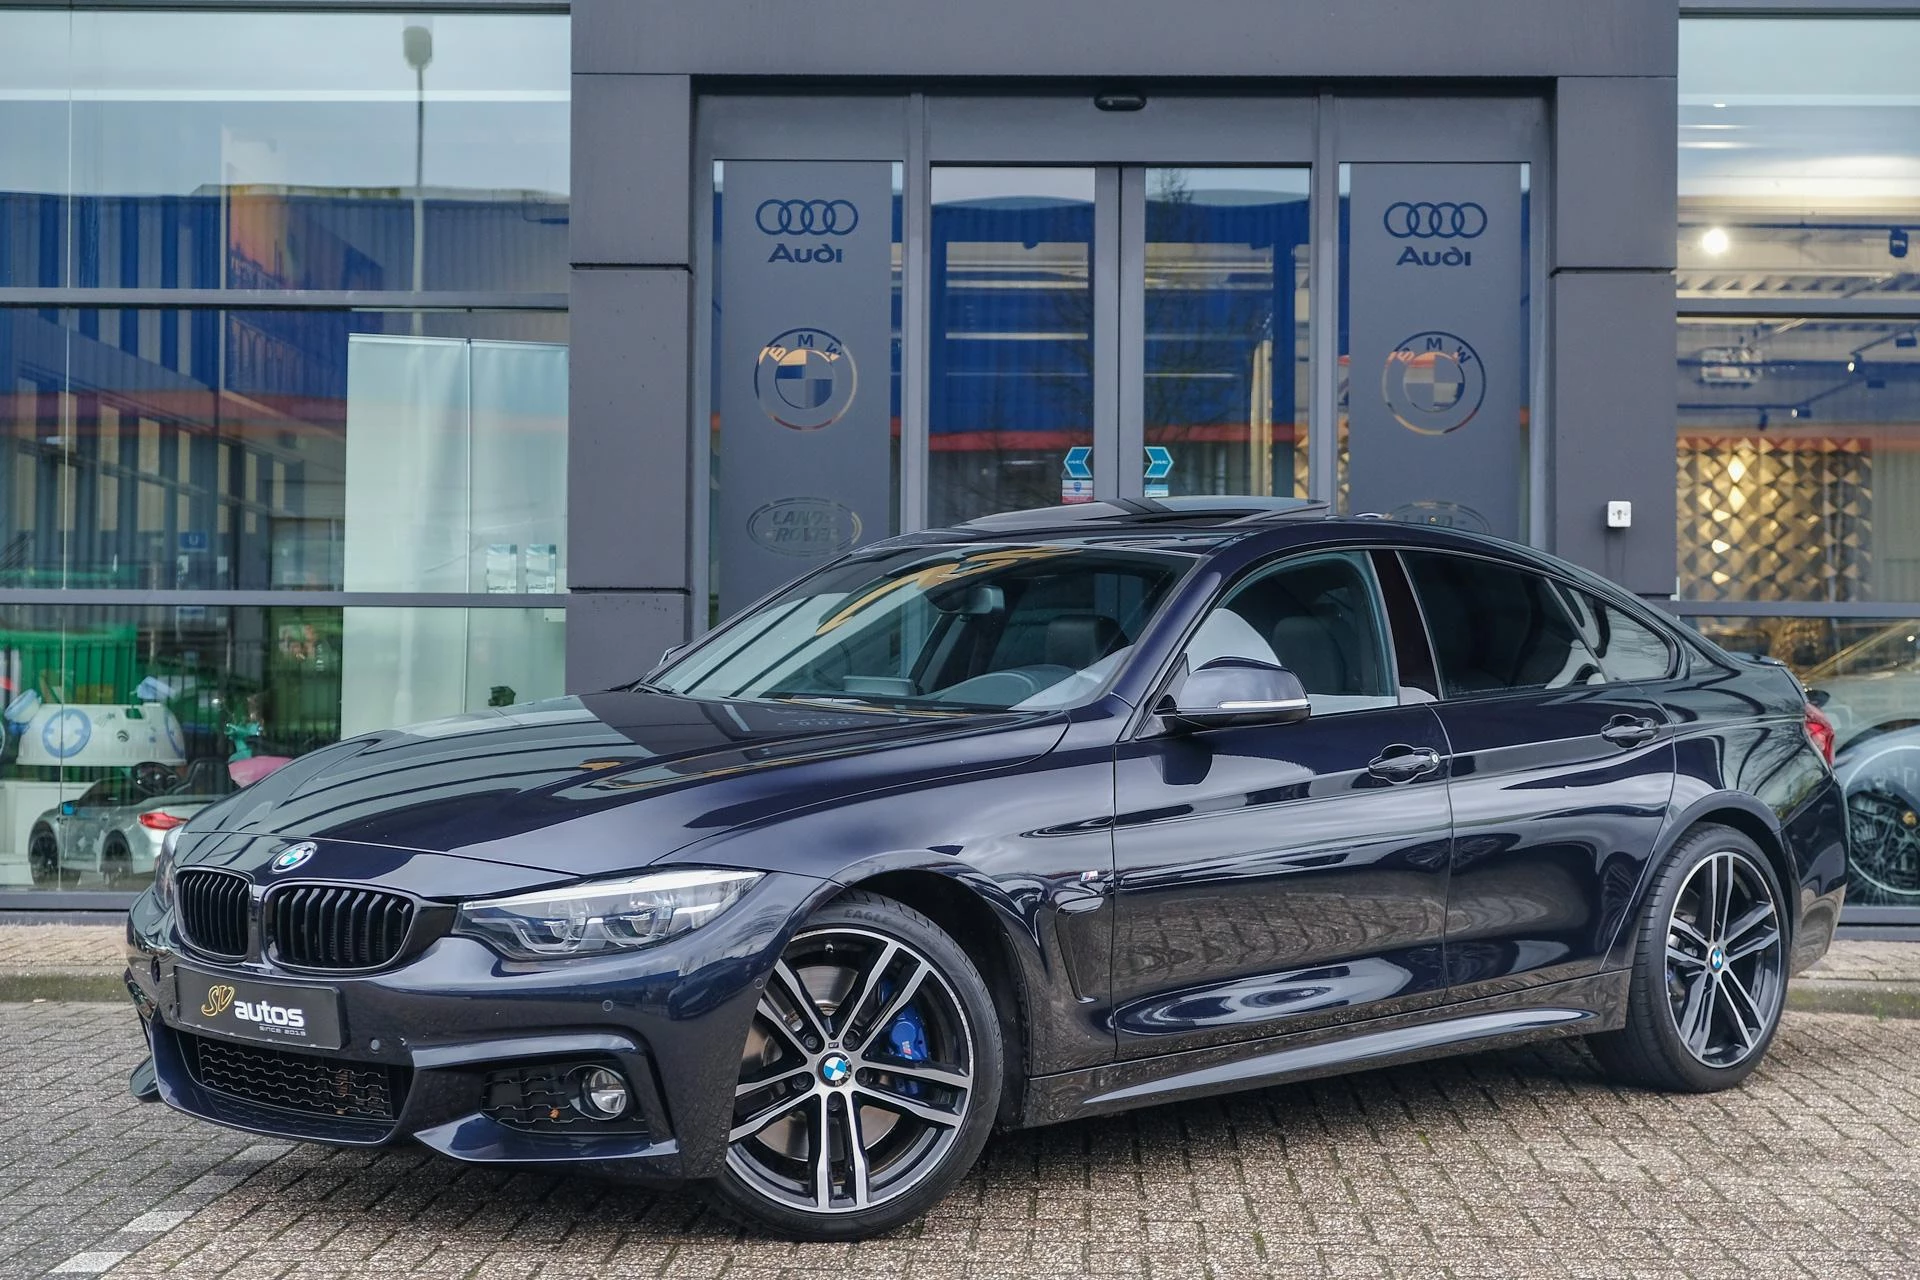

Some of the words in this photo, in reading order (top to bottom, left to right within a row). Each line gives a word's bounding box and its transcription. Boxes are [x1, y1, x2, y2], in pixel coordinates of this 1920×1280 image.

[768, 243, 843, 263] Audi
[1396, 246, 1472, 266] Audi
[767, 334, 841, 361] BMW
[1396, 337, 1472, 364] BMW
[234, 1000, 304, 1027] autos
